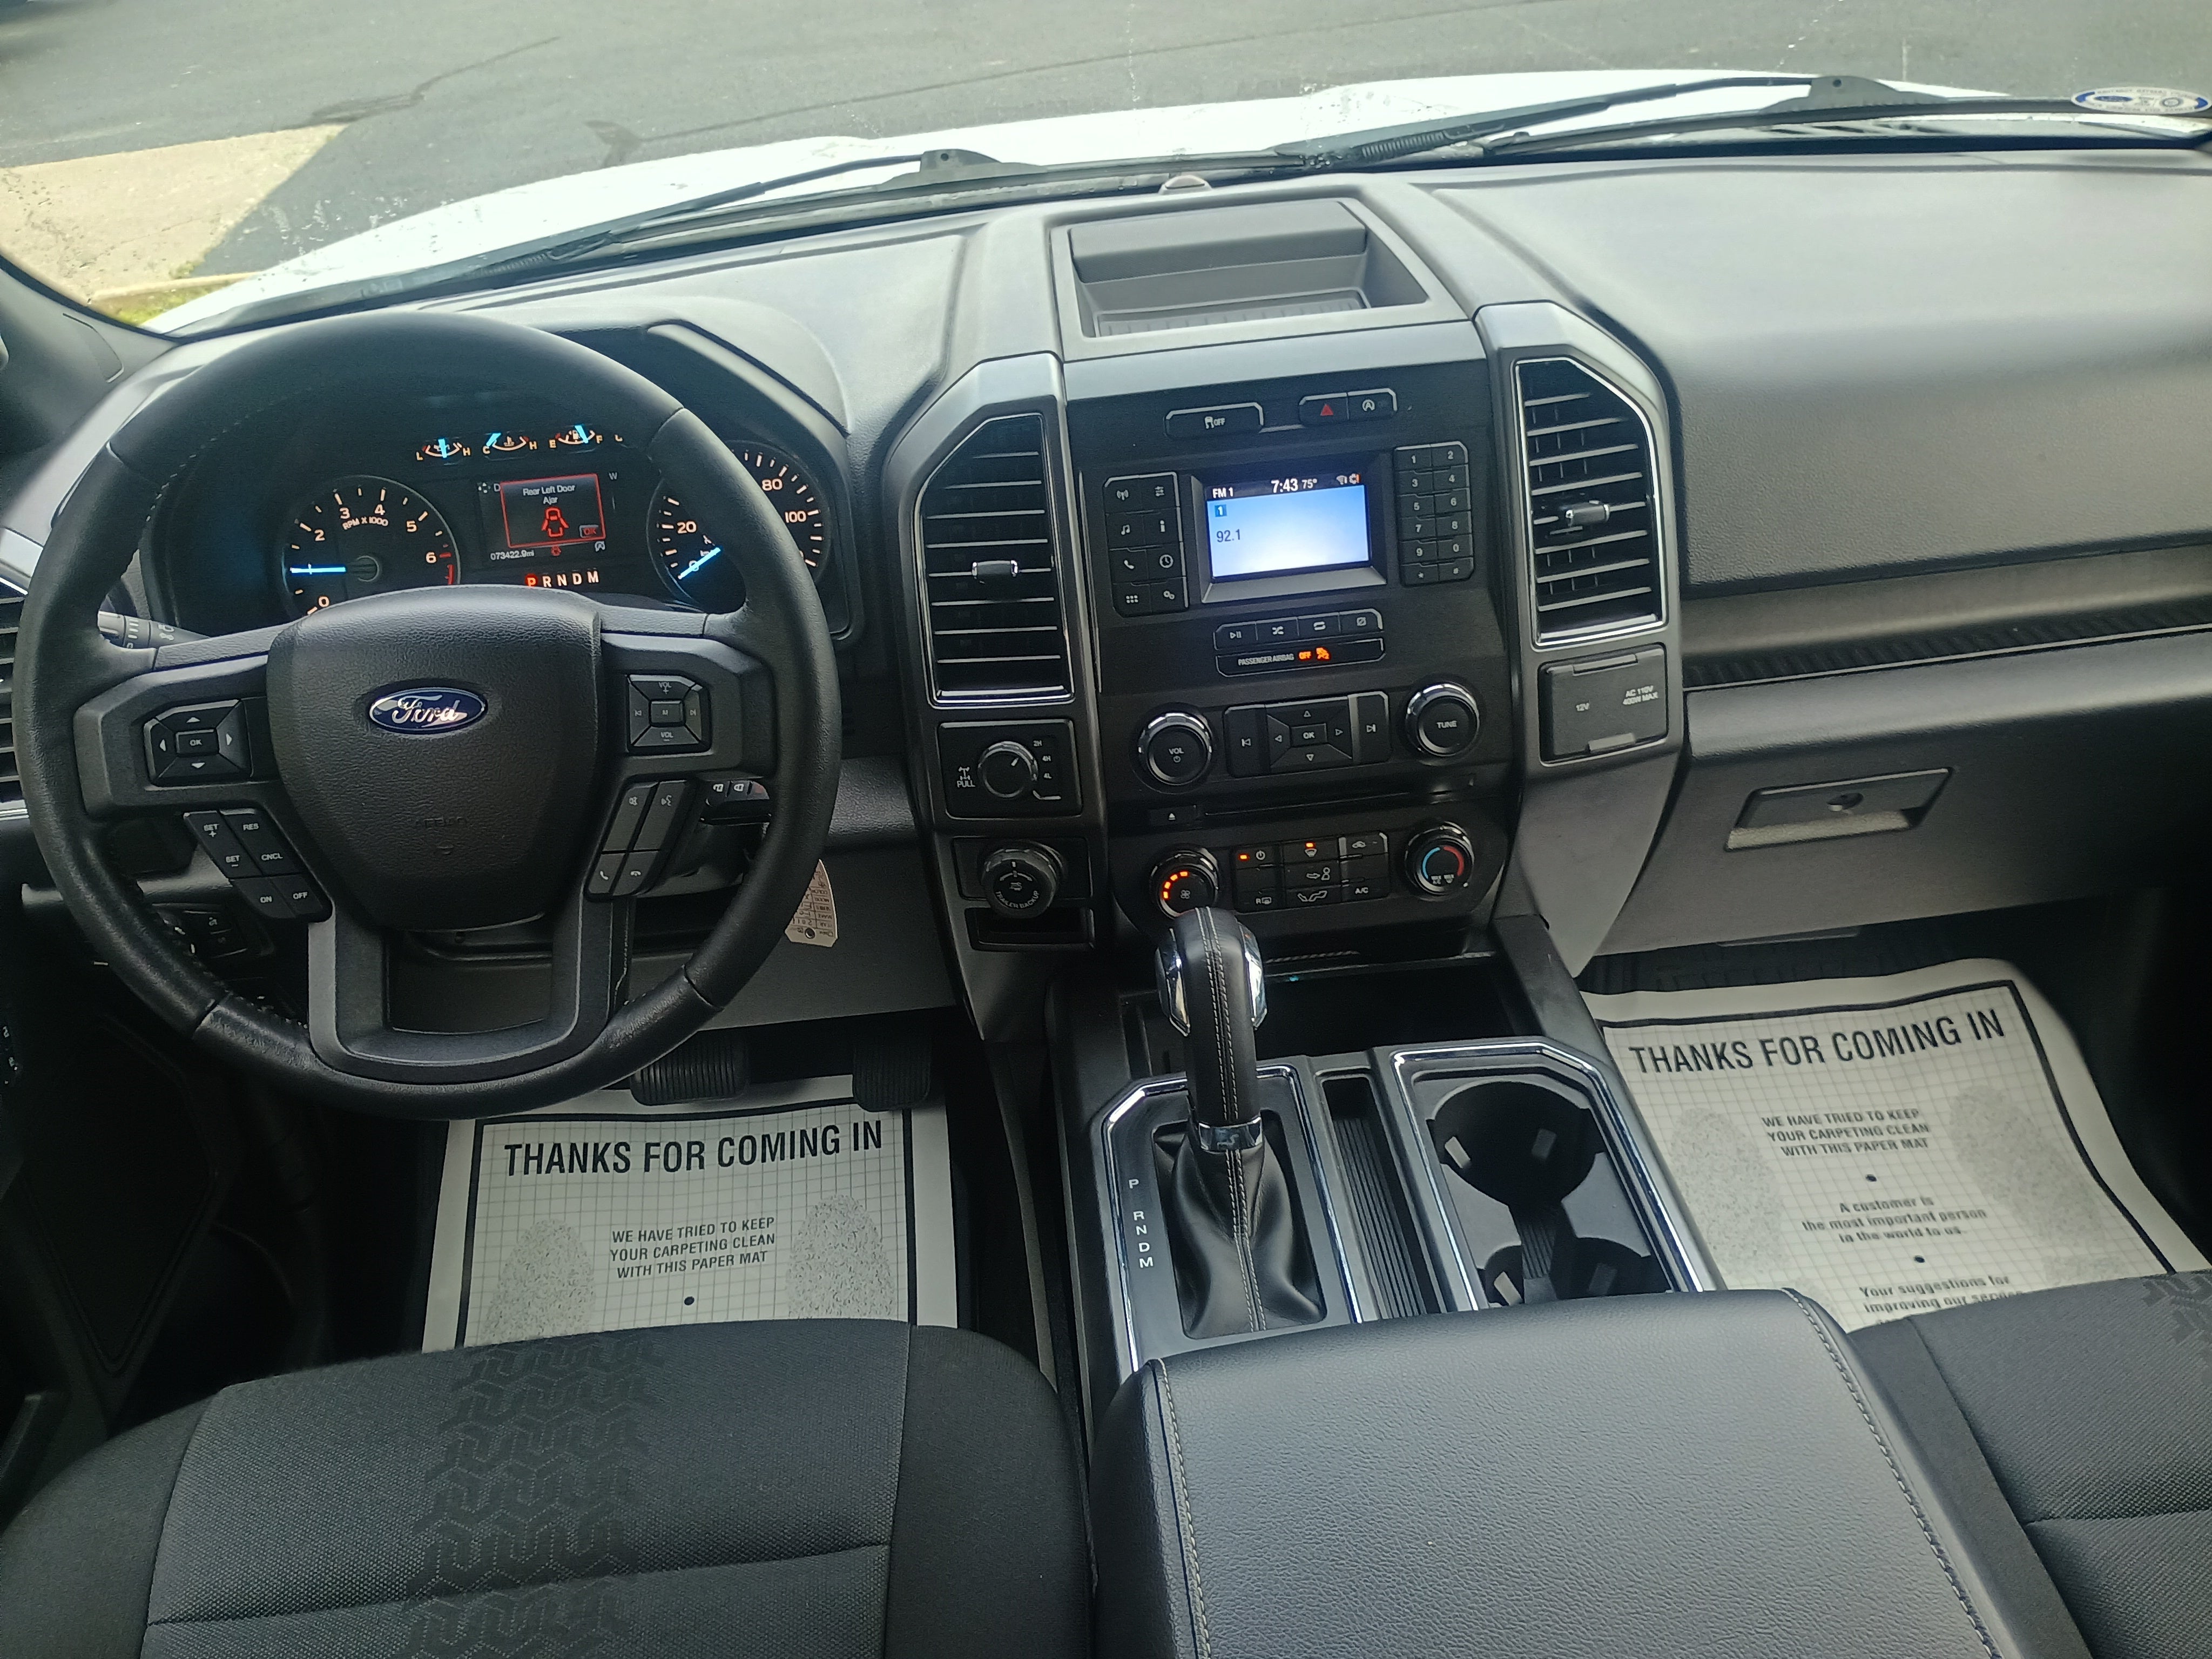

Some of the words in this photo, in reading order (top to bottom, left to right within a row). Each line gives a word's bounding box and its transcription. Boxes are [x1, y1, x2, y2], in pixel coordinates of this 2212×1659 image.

[549, 440, 556, 448] E
[596, 435, 603, 443] F
[483, 446, 490, 454] C
[529, 441, 537, 449] H
[416, 452, 423, 460] L
[463, 448, 471, 456] H
[1448, 450, 1453, 459] 2
[1412, 455, 1416, 463] 1
[609, 472, 617, 480] W
[762, 478, 783, 491] 80
[1271, 478, 1298, 493] 7:43
[1301, 478, 1317, 489] 75°
[1213, 488, 1226, 498] FM
[1229, 487, 1233, 497] 1
[1414, 502, 1420, 510] 5
[1451, 497, 1456, 506] 6
[340, 507, 350, 519] 3
[374, 504, 386, 515] 4
[1217, 506, 1223, 516] 1
[785, 510, 806, 523] 100
[342, 518, 360, 530] RPM
[369, 516, 389, 527] 1000
[406, 520, 417, 532] 5
[677, 521, 697, 534] 20
[1415, 524, 1421, 532] 7
[1452, 521, 1458, 529] 8
[314, 529, 325, 541] 2
[1216, 529, 1240, 543] 92.1
[1417, 548, 1422, 556] 9
[1453, 544, 1459, 552] 0
[426, 552, 436, 563] 6
[527, 578, 536, 586] P
[543, 576, 551, 587] R
[557, 575, 567, 586] N
[572, 574, 582, 585] D
[587, 571, 599, 583] M
[318, 596, 329, 607] 0
[1238, 655, 1273, 666] PASSENGER
[1272, 653, 1294, 662] AIRBAG
[1299, 651, 1311, 659] OFF
[1626, 689, 1636, 697] AC
[1637, 685, 1654, 694] 110V
[1642, 692, 1658, 701] MAX
[392, 694, 460, 724] Ford
[1576, 703, 1590, 711] 12V
[1437, 720, 1458, 730] TUNE
[1303, 731, 1315, 739] OK
[1628, 1041, 1754, 1073] THANKS
[1758, 1035, 1825, 1067] FOR
[1832, 1016, 1961, 1062] COMING
[1966, 1008, 2005, 1041] IN
[1762, 1116, 1784, 1127] WE
[1786, 1114, 1822, 1126] HAVE
[1824, 1111, 1864, 1124] TRIED
[1865, 1110, 1884, 1121] TO
[1887, 1108, 1919, 1120] KEEP
[1767, 1130, 1806, 1142] YOUR
[1809, 1125, 1884, 1140] CARPETING
[1886, 1122, 1930, 1135] CLEAN
[504, 1141, 631, 1176] THANKS
[644, 1141, 705, 1173] FOR
[718, 1124, 840, 1168] COMING
[853, 1120, 882, 1151] IN
[1781, 1145, 1818, 1156] WITH
[1820, 1142, 1852, 1154] THIS
[1853, 1139, 1898, 1152] PAPER
[1900, 1137, 1928, 1149] MAT
[1129, 1179, 1139, 1189] P
[1839, 1202, 1850, 1213] A
[1852, 1198, 1917, 1211] customer
[1919, 1196, 1934, 1207] is
[1133, 1211, 1144, 1221] R
[1802, 1220, 1825, 1231] the
[1829, 1217, 1864, 1230] most
[1867, 1210, 1936, 1227] important
[1938, 1209, 1988, 1223] person
[612, 1230, 633, 1243] WE
[638, 1229, 673, 1242] HAVE
[677, 1223, 715, 1238] TRIED
[720, 1220, 737, 1233] TO
[742, 1217, 774, 1231] KEEP
[1136, 1225, 1147, 1236] N
[1839, 1233, 1854, 1243] in
[1856, 1231, 1880, 1242] the
[1883, 1227, 1923, 1239] world
[1925, 1226, 1941, 1237] to
[610, 1247, 648, 1262] YOUR
[653, 1238, 727, 1258] CARPETING
[733, 1233, 775, 1249] CLEAN
[1138, 1242, 1150, 1252] D
[617, 1264, 652, 1278] WITH
[657, 1260, 687, 1274] THIS
[692, 1254, 734, 1270] PAPER
[739, 1250, 768, 1264] MAT
[1139, 1257, 1154, 1268] M
[1860, 1286, 1893, 1297] Your
[1898, 1277, 1986, 1294] suggestions
[1988, 1275, 2010, 1286] for
[1864, 1298, 1941, 1313] improving
[1944, 1296, 1968, 1306] our
